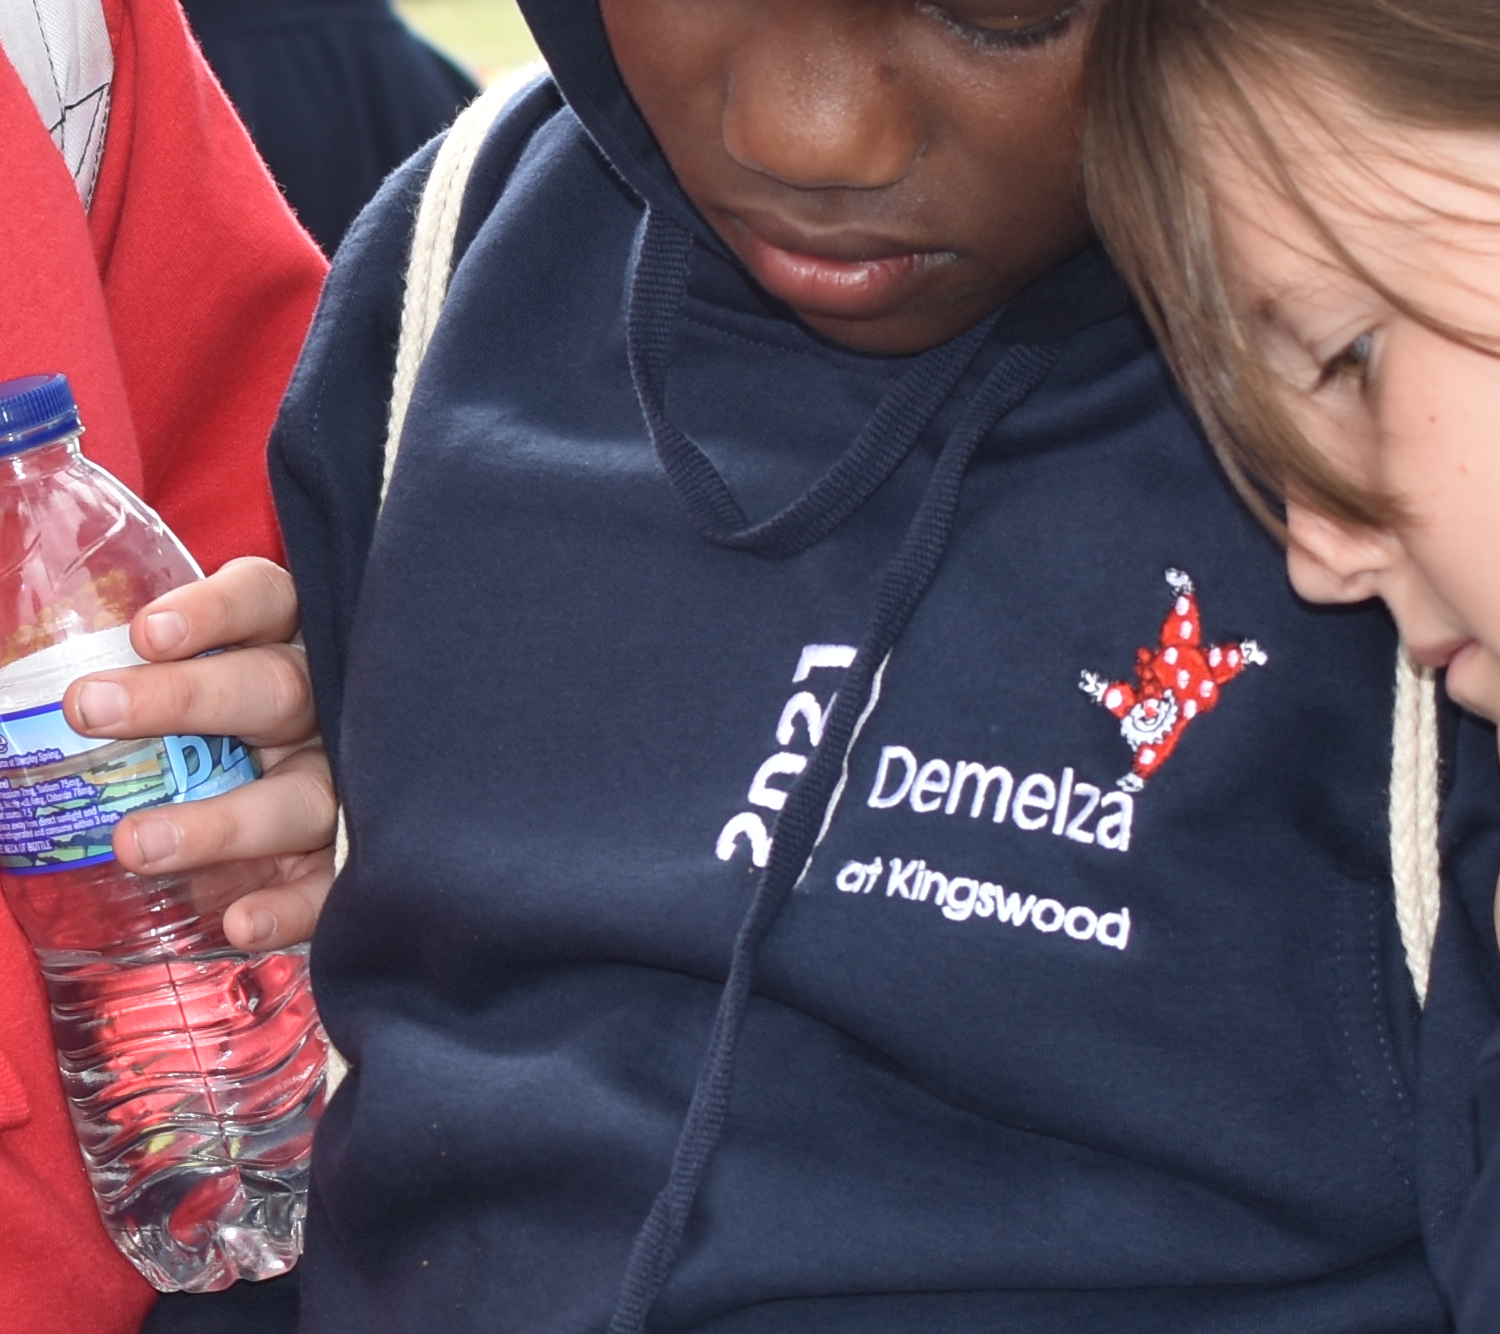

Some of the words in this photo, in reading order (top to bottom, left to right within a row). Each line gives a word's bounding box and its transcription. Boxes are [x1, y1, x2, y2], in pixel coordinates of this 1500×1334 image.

[95, 816, 100, 825] 3
[866, 744, 1136, 853] Demelza
[27, 840, 52, 850] BOTTLE
[836, 856, 883, 894] at
[885, 857, 1132, 951] Kingswood
